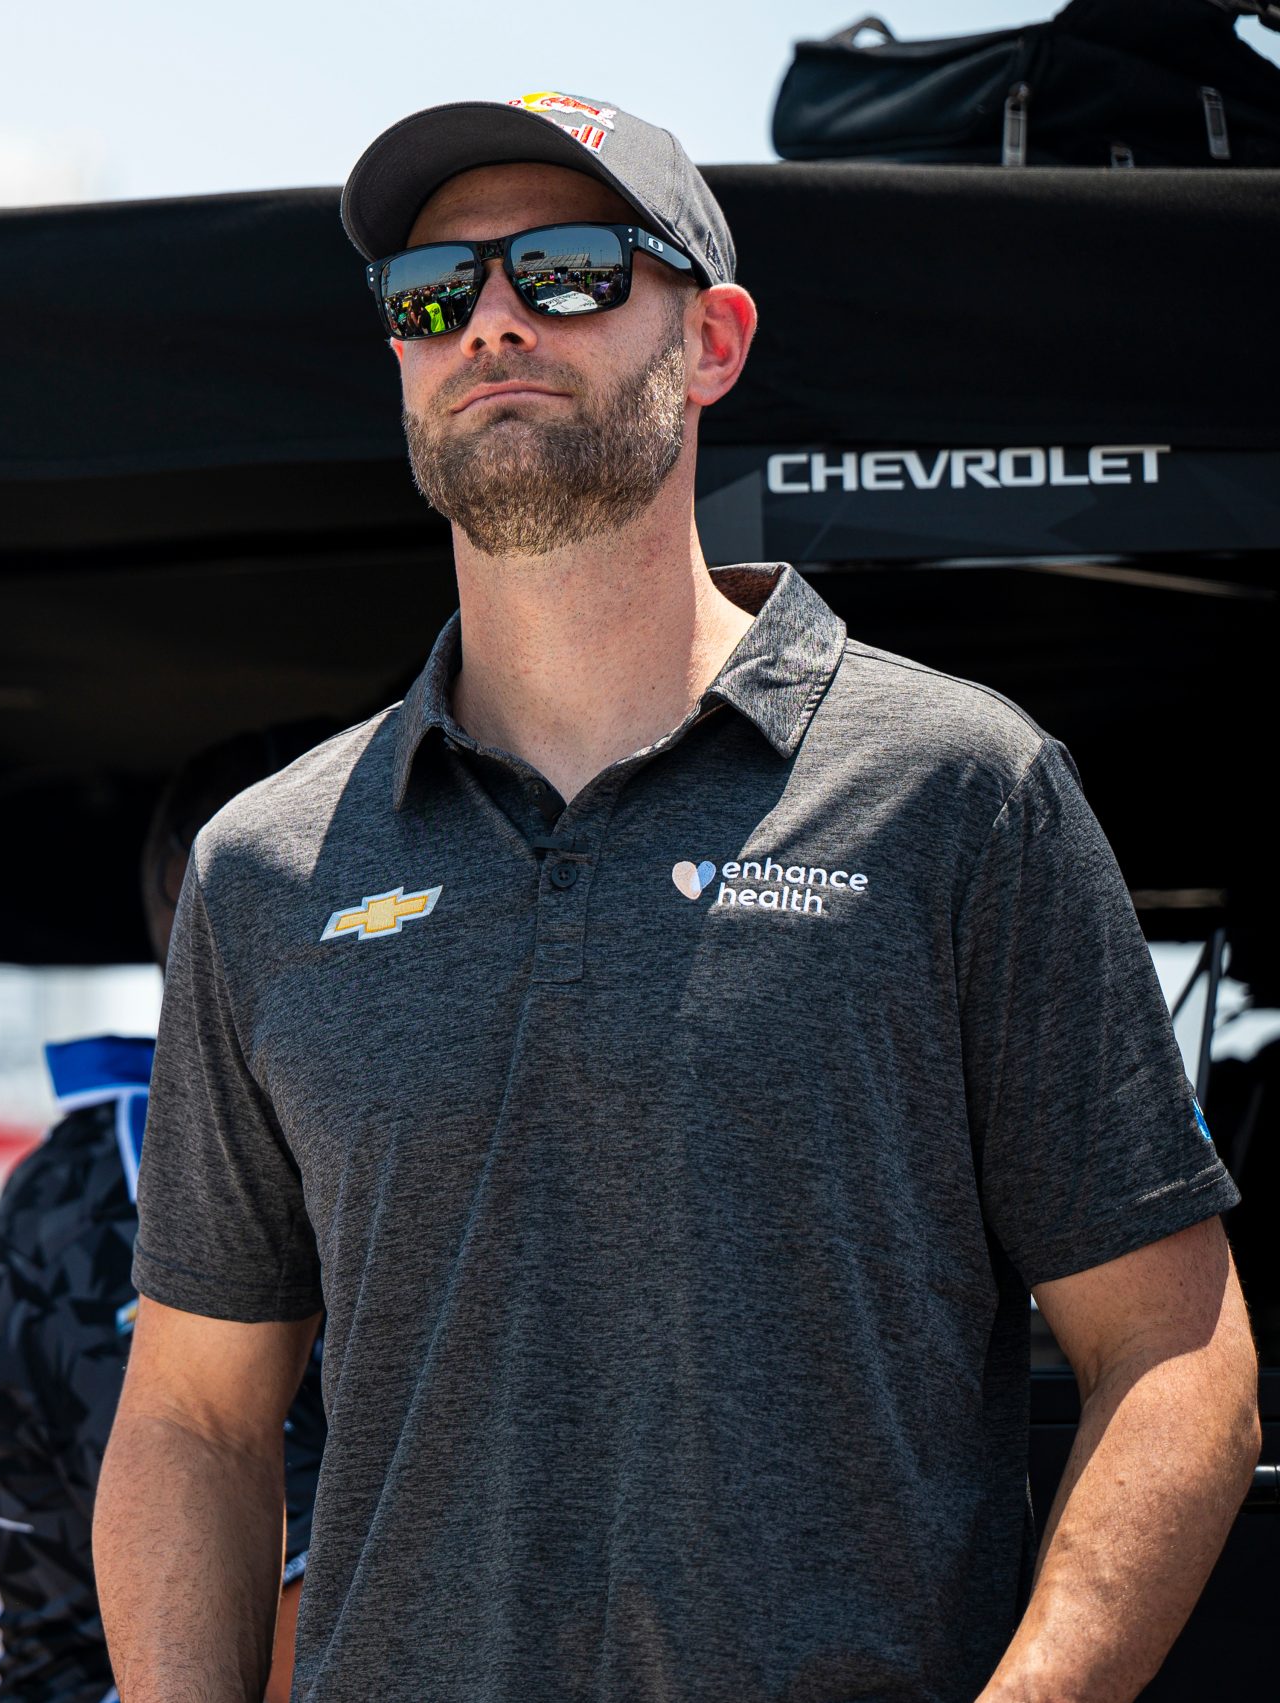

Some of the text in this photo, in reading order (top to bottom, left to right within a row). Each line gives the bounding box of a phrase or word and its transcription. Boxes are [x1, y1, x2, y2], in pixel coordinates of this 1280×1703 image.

[767, 444, 1171, 494] CHEVROLET
[721, 857, 869, 892] enhance
[717, 882, 823, 914] health
